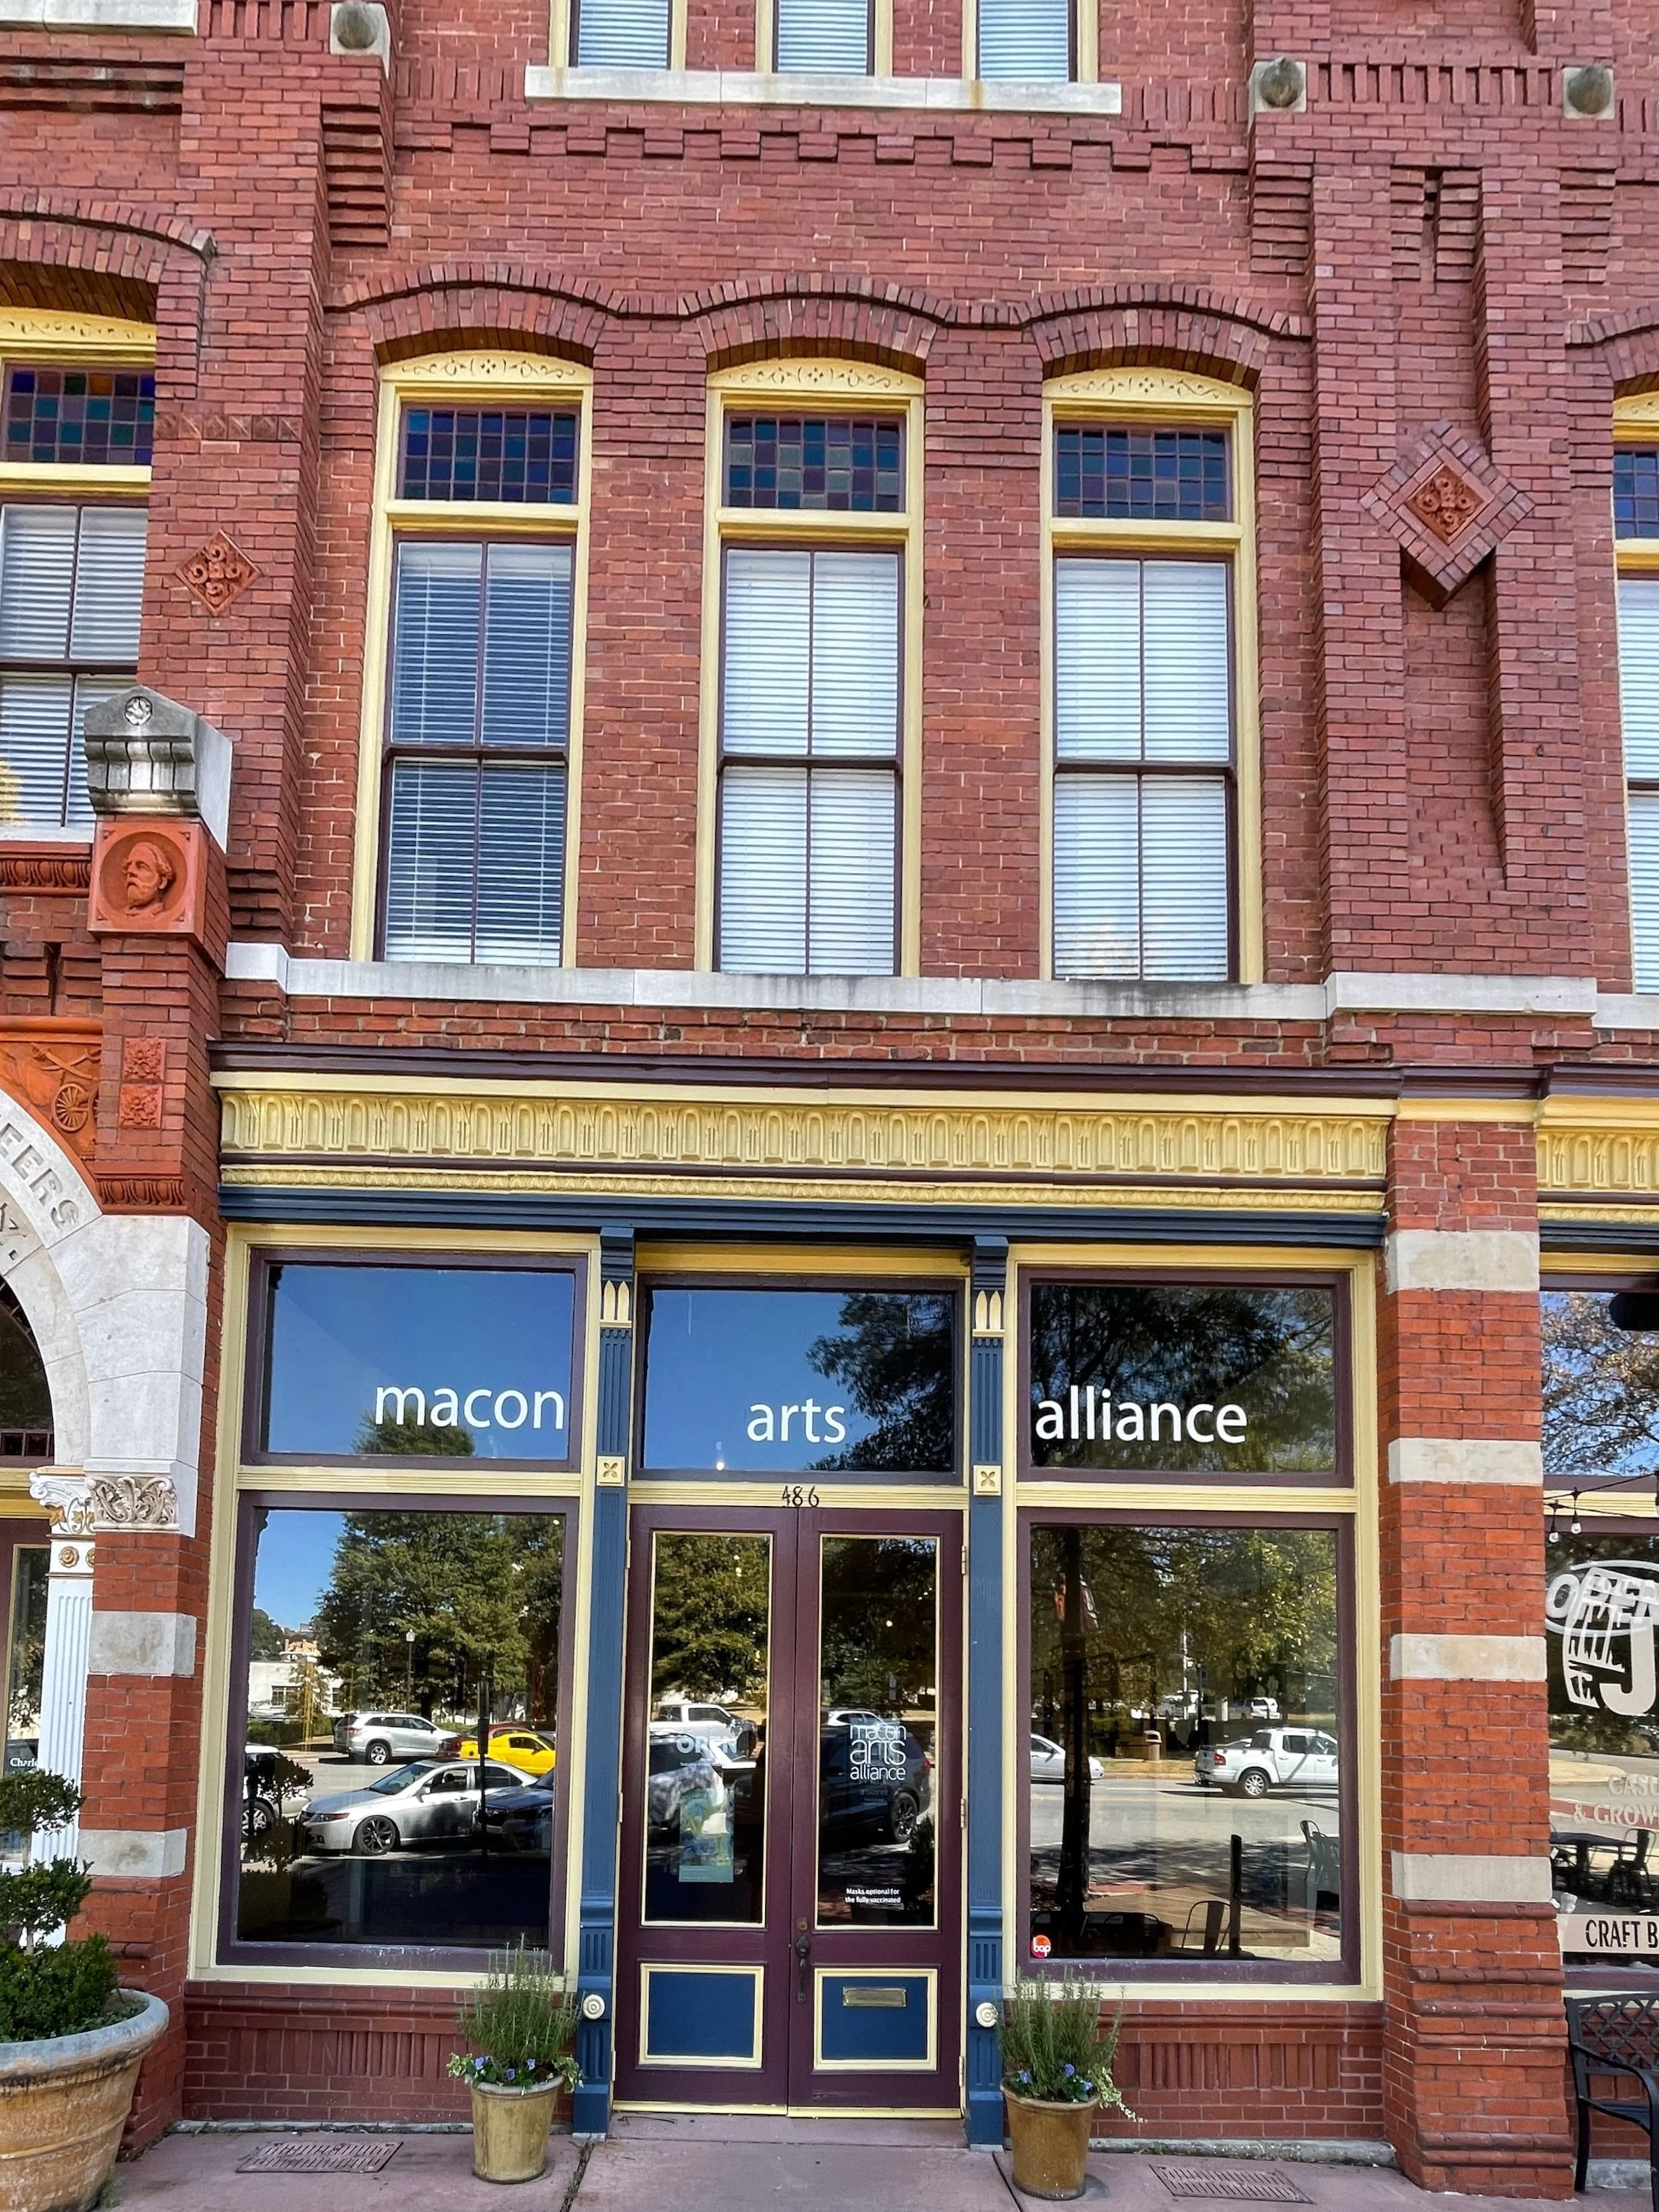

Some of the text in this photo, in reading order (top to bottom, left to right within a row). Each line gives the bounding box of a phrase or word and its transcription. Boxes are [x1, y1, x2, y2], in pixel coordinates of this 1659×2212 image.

[375, 1385, 1248, 1444] macon arts alliance
[782, 1486, 819, 1507] 486
[850, 1724, 906, 1740] macon
[676, 1734, 737, 1754] OPN
[850, 1739, 906, 1765] arts
[850, 1764, 906, 1781] alliance
[1573, 1803, 1659, 1825] & GROW
[855, 1896, 869, 1904] fully
[1585, 1919, 1641, 1947] CRAFT
